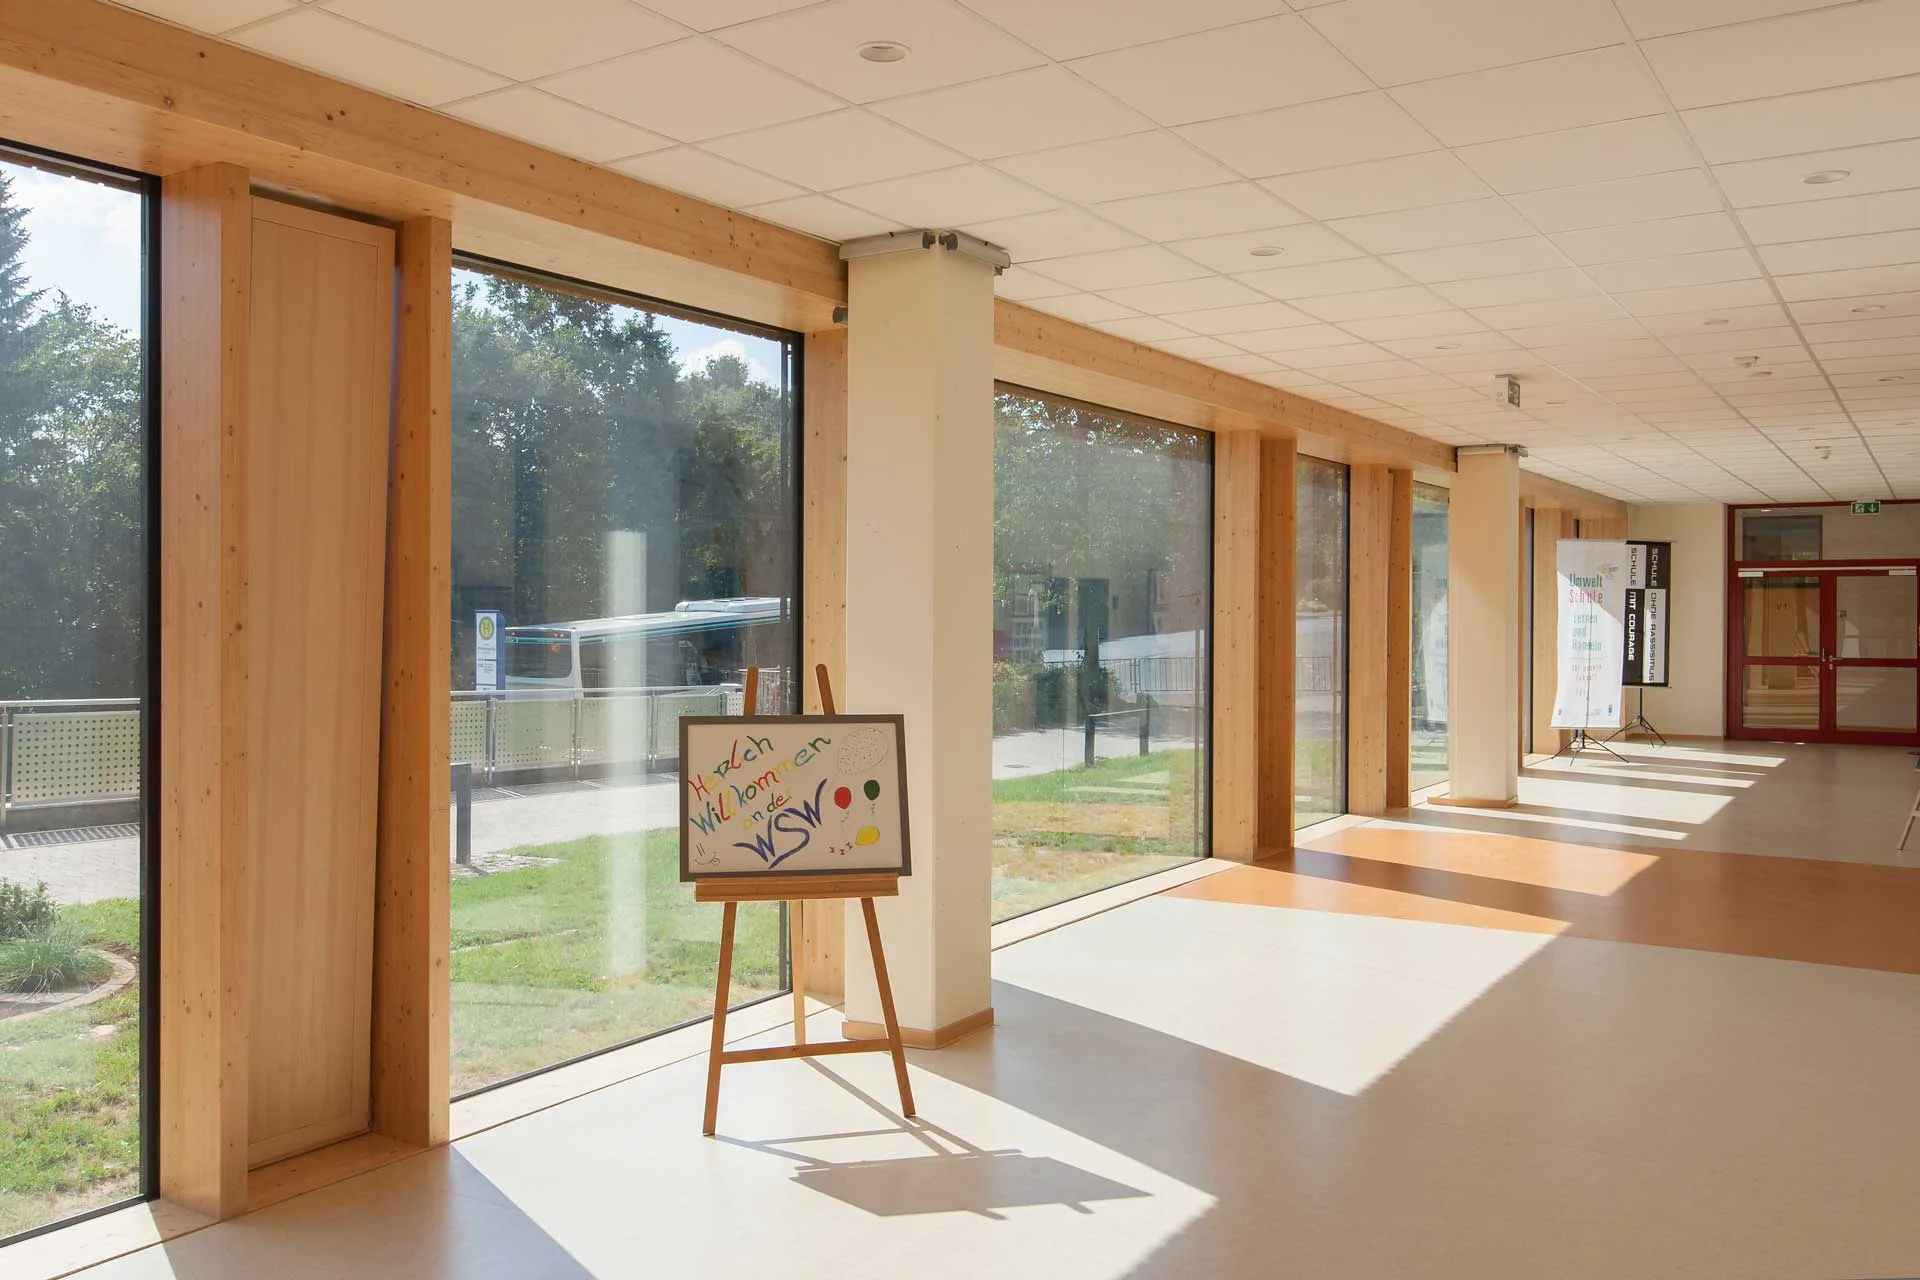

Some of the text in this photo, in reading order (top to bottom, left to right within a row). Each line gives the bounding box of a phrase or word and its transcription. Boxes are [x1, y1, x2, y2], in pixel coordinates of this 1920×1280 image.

[1569, 573, 1603, 588] Umwelt
[1569, 589, 1603, 604] Schule
[1629, 591, 1637, 610] MIT
[1628, 613, 1636, 661] COURAGE
[687, 735, 774, 802] Herzlich
[689, 736, 832, 836] Willkommen
[732, 778, 828, 869] WSW
